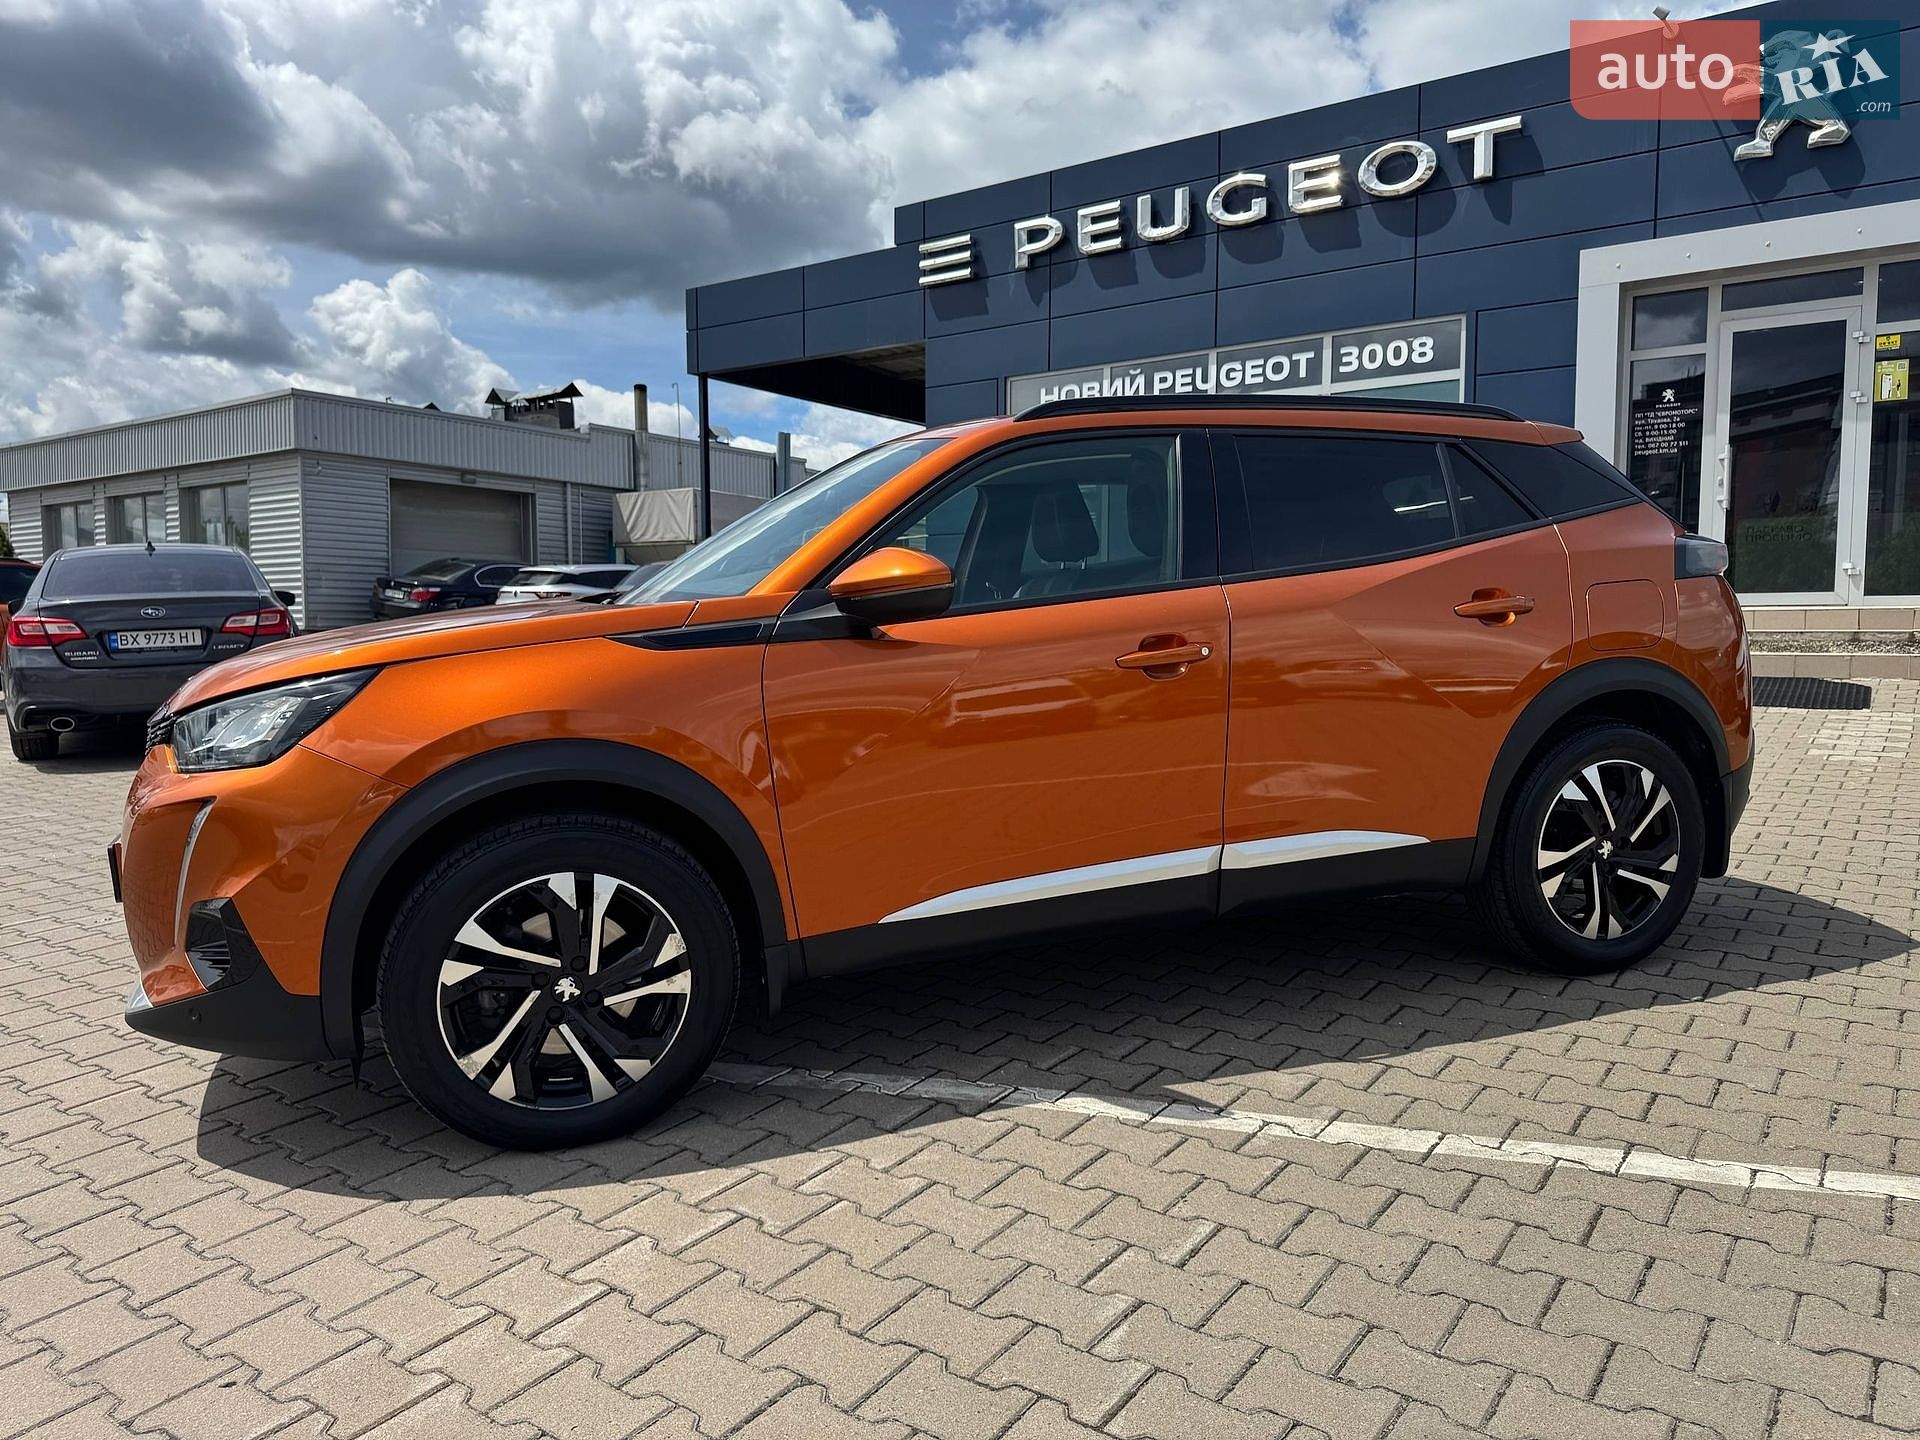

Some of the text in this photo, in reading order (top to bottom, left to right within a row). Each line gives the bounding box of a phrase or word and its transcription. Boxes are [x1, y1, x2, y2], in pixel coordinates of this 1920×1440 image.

[1014, 115, 1523, 271] PEUGEOT
[1153, 351, 1315, 396] PEUGEOT
[1338, 335, 1435, 373] 3008
[119, 631, 196, 646] BX 9773 HI
